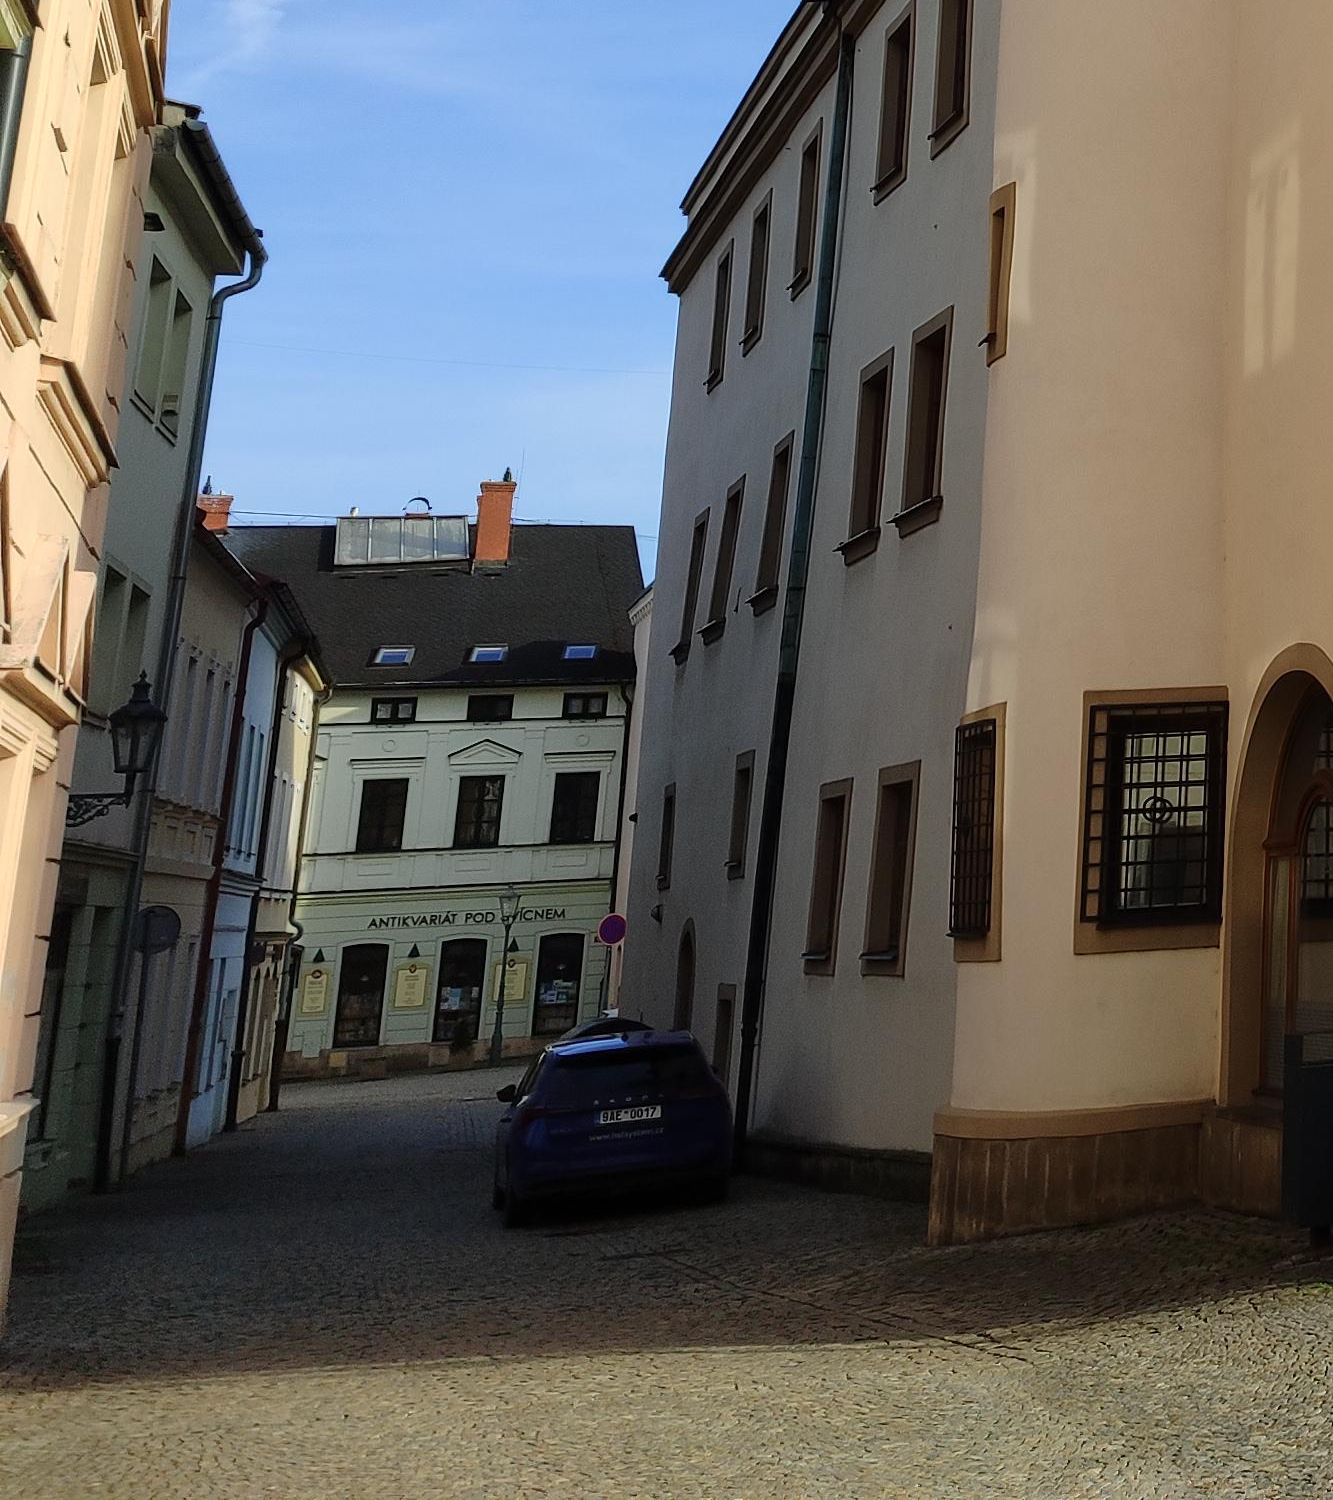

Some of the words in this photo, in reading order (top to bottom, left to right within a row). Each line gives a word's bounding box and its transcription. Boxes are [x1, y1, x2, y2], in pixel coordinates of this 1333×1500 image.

[367, 911, 458, 929] ANTIKVARIÁT
[464, 912, 496, 924] POD
[629, 1106, 657, 1119] 0017
